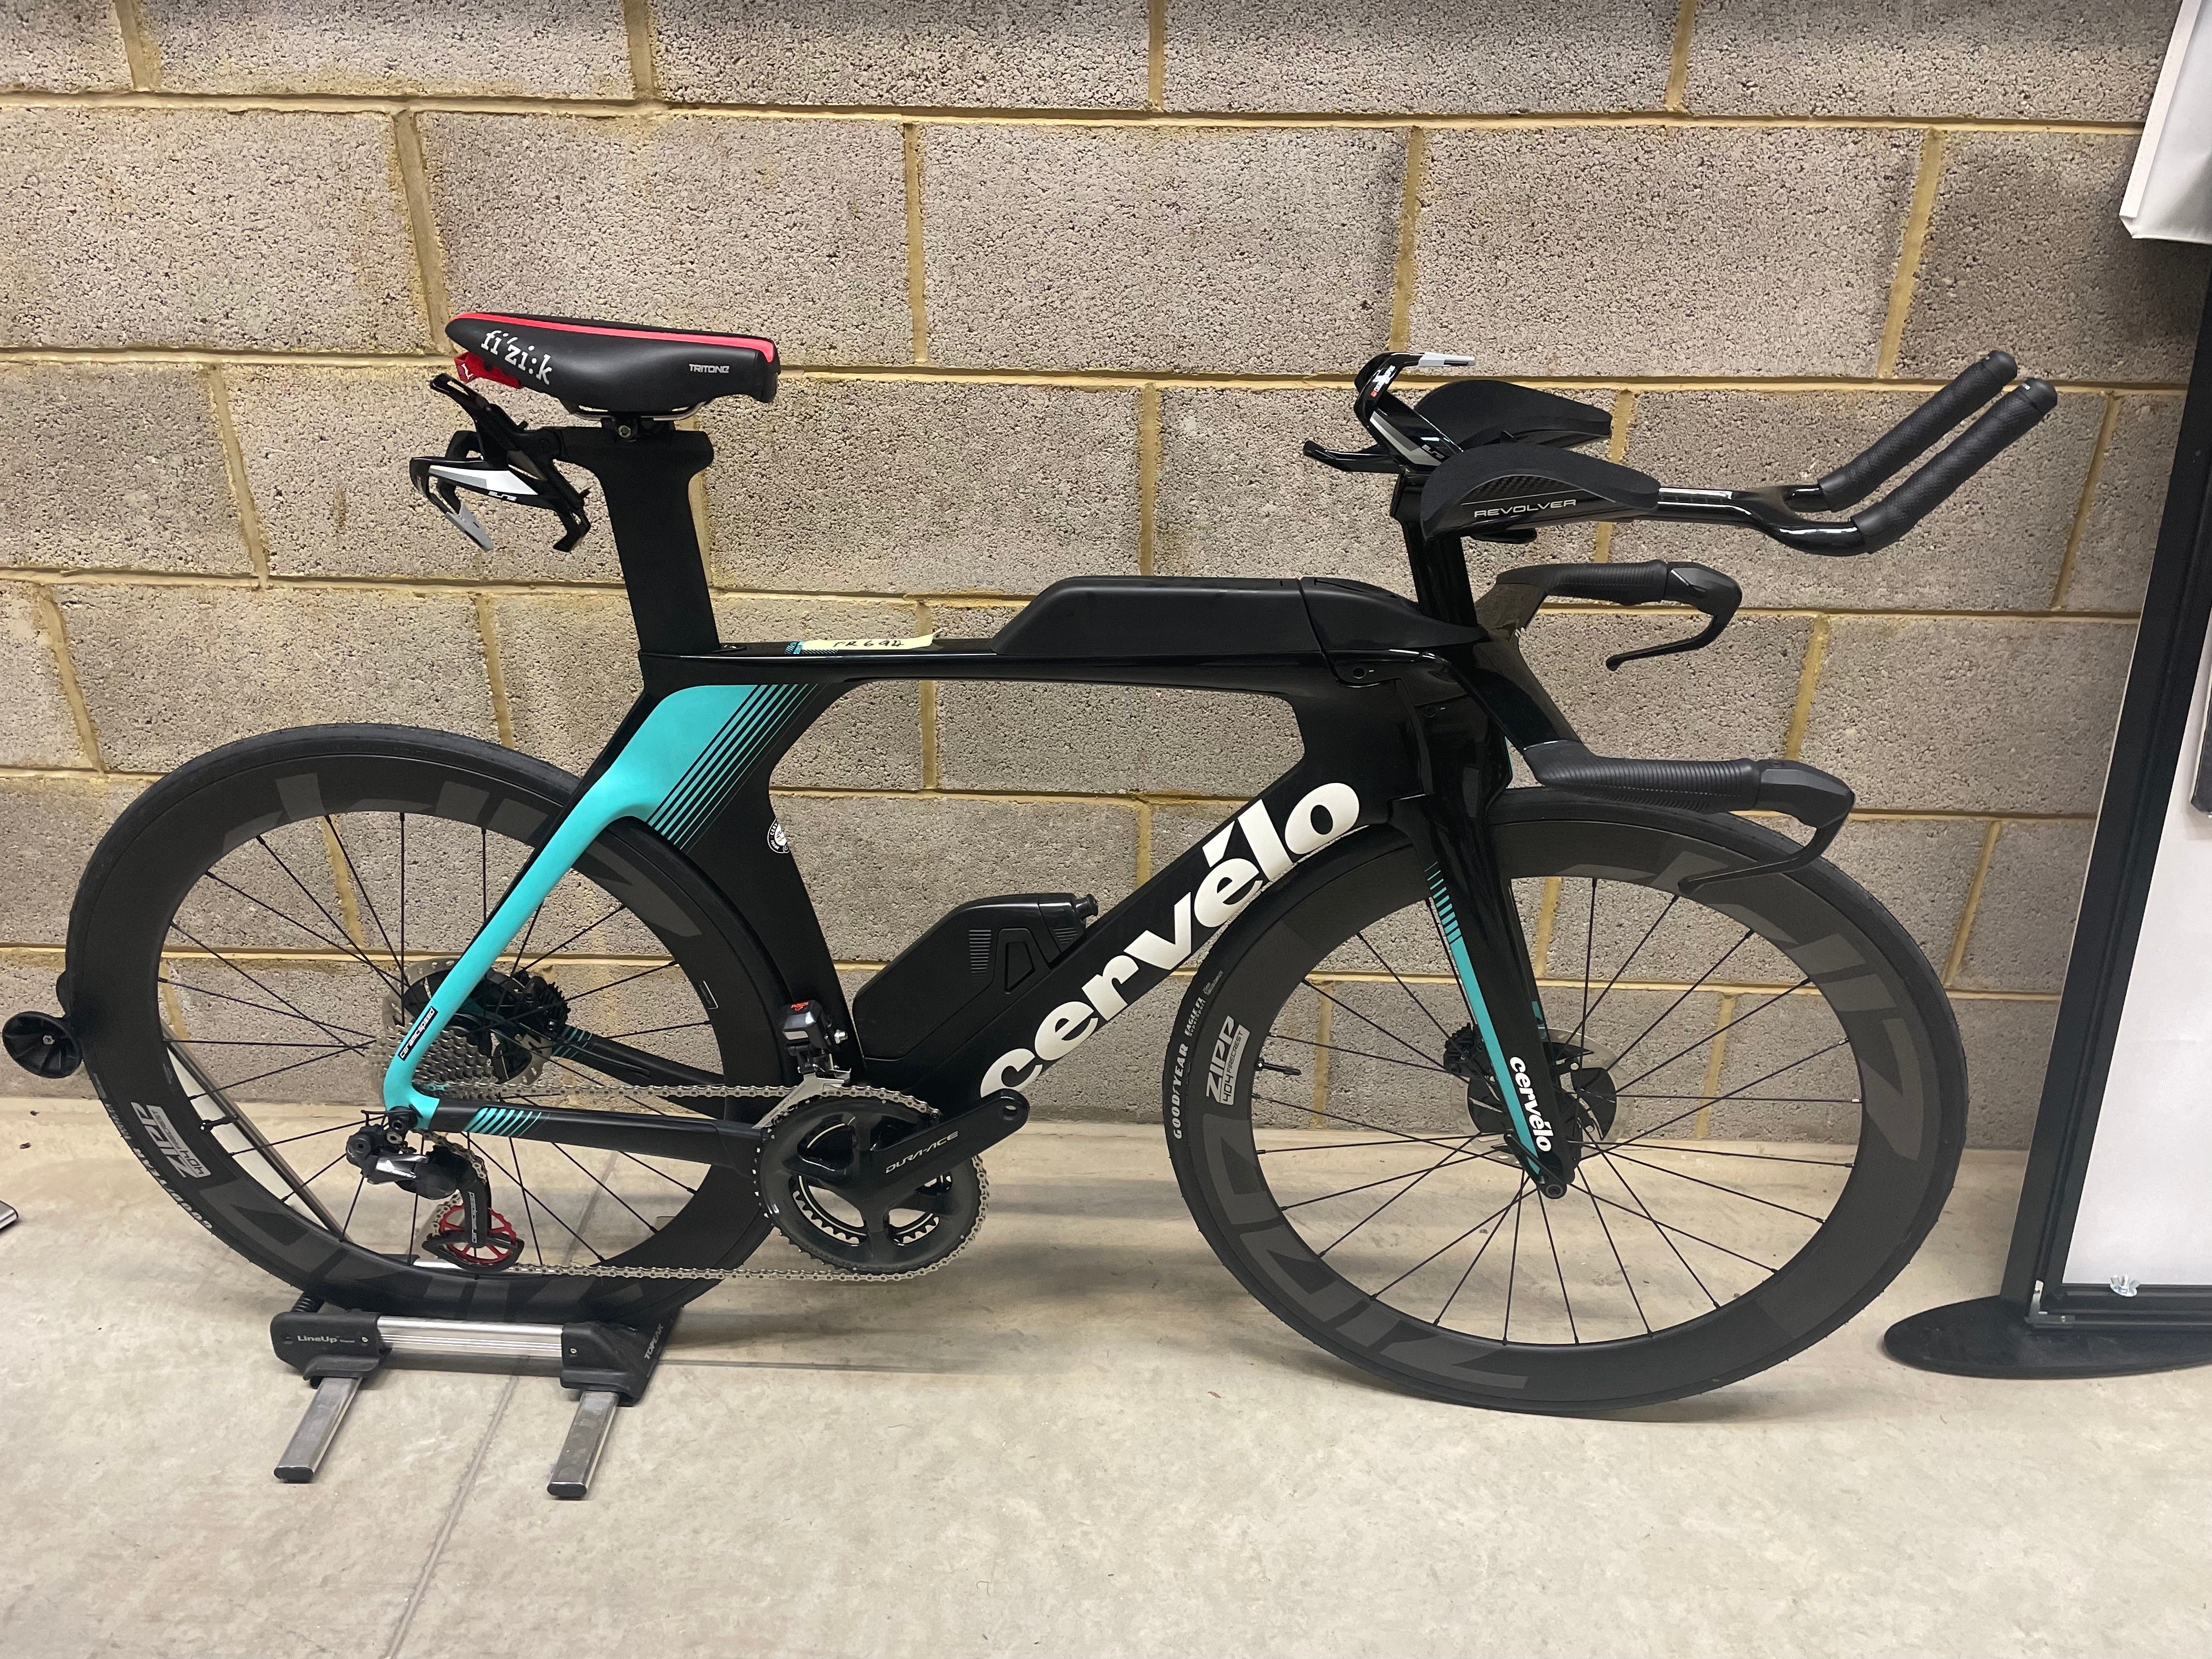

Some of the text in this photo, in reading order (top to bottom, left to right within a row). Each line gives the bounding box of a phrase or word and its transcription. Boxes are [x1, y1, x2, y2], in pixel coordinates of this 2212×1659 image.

[689, 364, 730, 373] TRITONE
[1474, 499, 1577, 518] REVOLVER
[980, 782, 1360, 1098] cervélo
[1184, 1007, 1198, 1036] EAGLE
[1206, 1015, 1234, 1103] ZIPP
[1222, 1030, 1243, 1102] 404 FIRECREST
[1171, 1043, 1189, 1139] GOODYEAR
[1509, 1056, 1554, 1152] cervélo
[130, 1102, 199, 1178] ZIPP
[885, 1131, 958, 1174] DURA-ACE
[179, 1150, 205, 1175] 404
[297, 1335, 337, 1344] LineUp
[644, 1323, 664, 1359] TOPEAK
